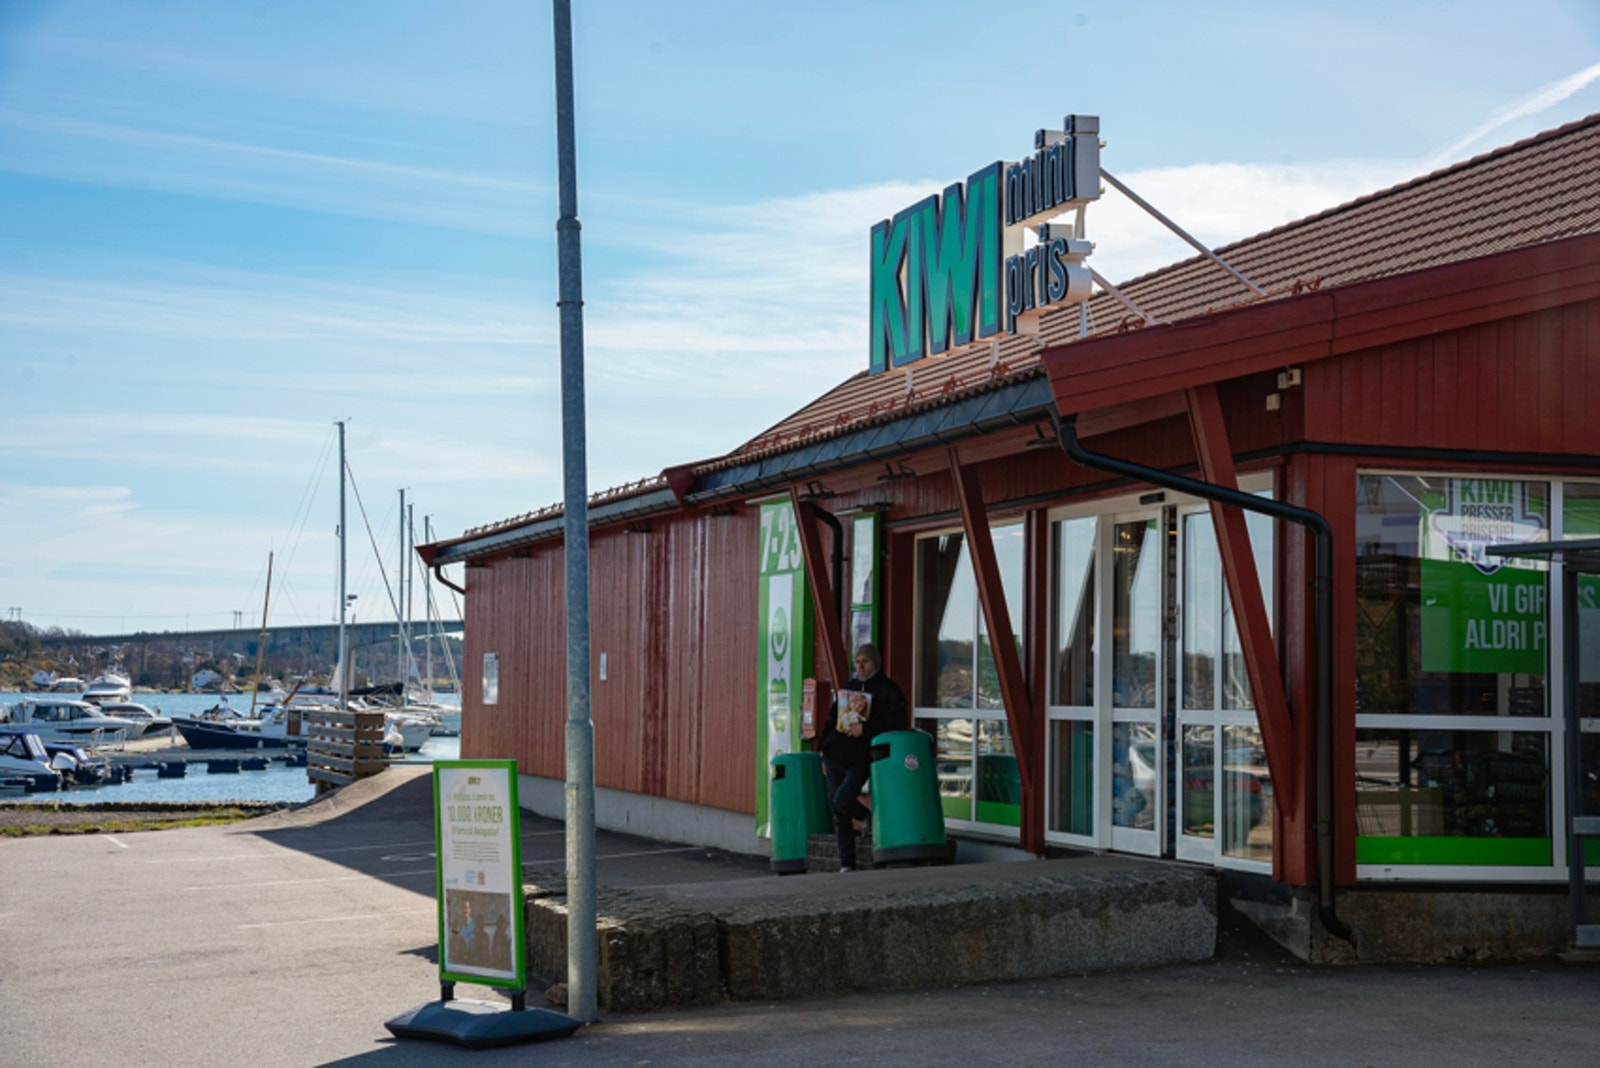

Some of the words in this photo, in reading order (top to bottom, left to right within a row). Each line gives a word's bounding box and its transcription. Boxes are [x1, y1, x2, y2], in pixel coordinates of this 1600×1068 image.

[1006, 115, 1077, 226] mini
[869, 160, 1003, 376] KIWI
[1006, 223, 1069, 335] pris
[1461, 479, 1514, 503] KIWI
[1461, 504, 1514, 522] PRESSER
[1489, 584, 1508, 613] VI
[1465, 619, 1526, 650] ALDRI
